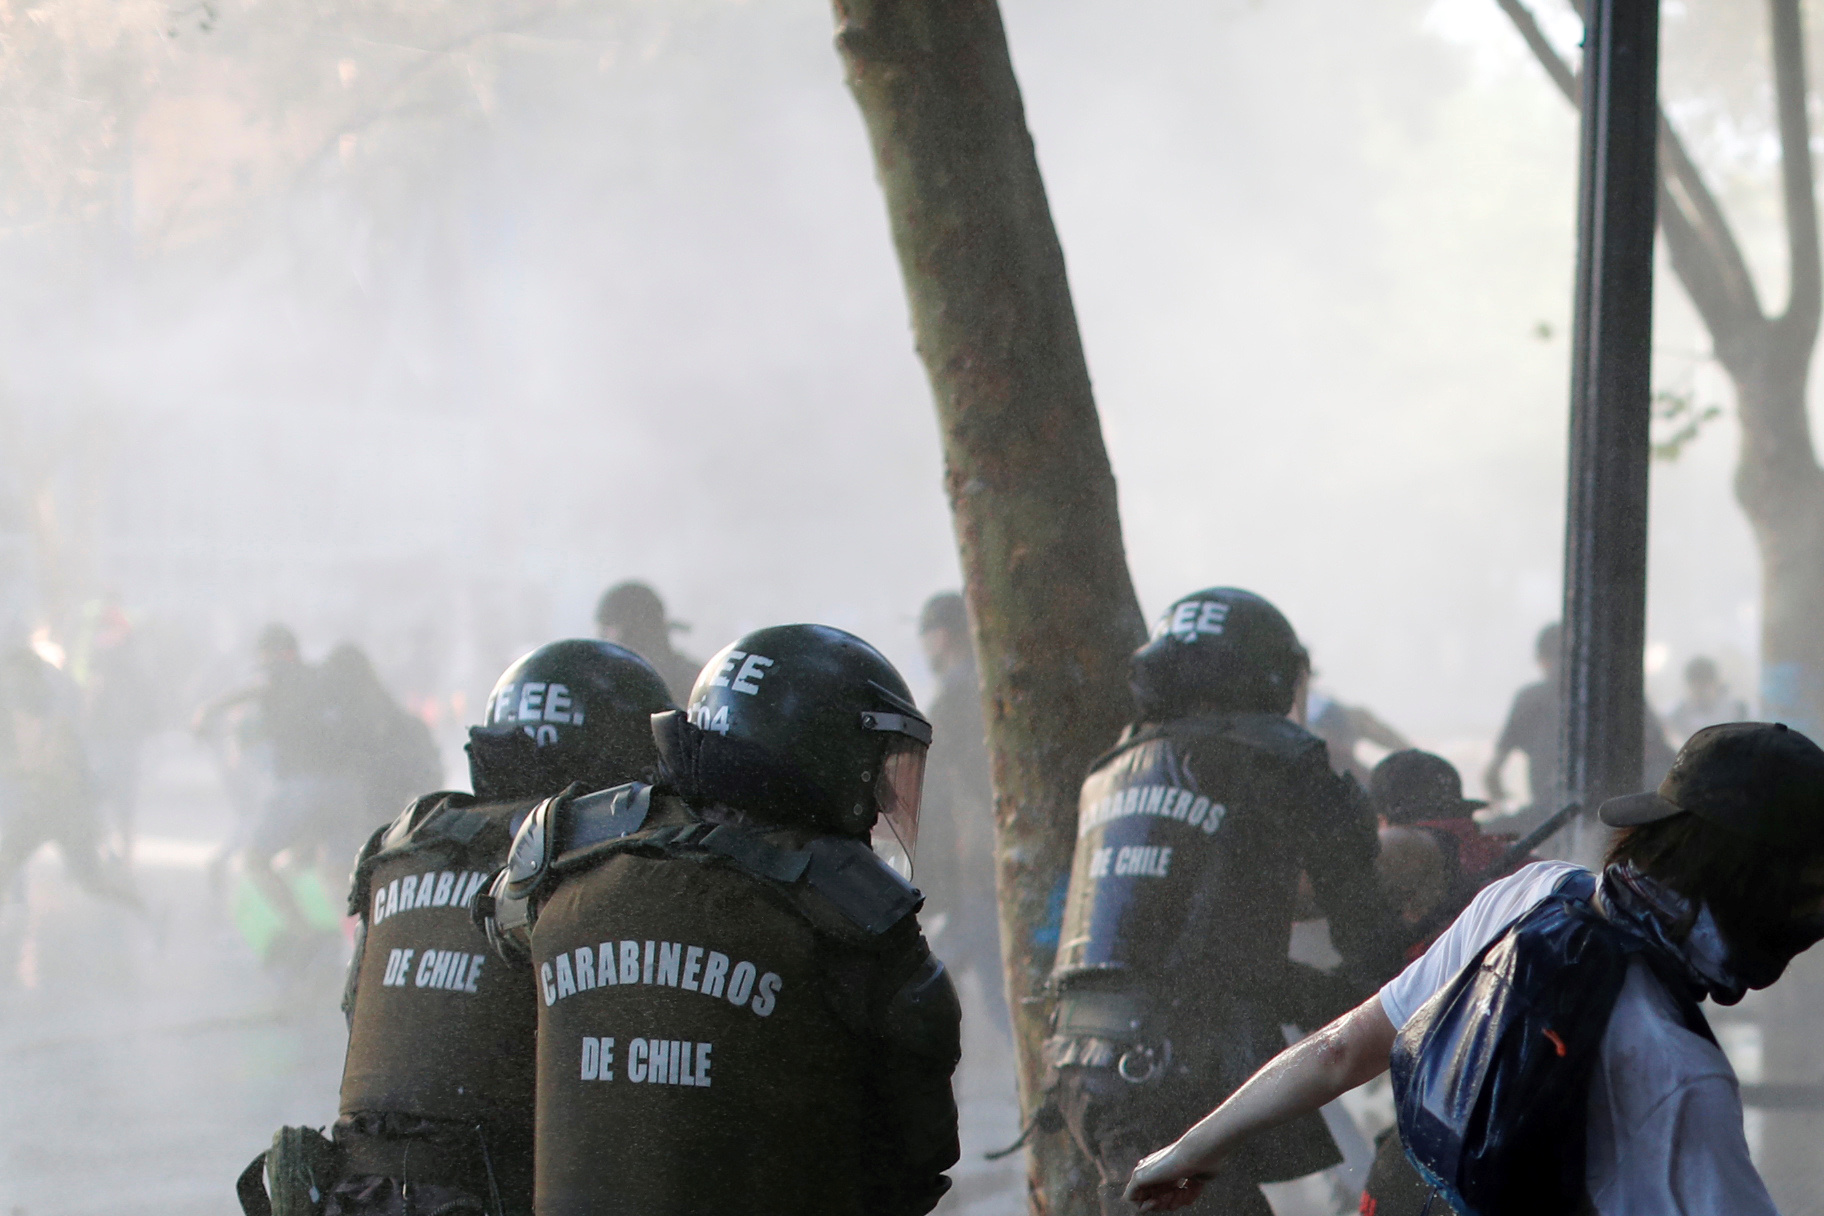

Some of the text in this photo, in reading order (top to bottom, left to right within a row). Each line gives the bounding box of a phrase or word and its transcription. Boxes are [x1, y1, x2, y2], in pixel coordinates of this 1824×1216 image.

[1114, 845, 1173, 878] CHILE
[373, 870, 488, 926] CARABIN
[382, 948, 486, 994] DE CHILE
[541, 940, 783, 1017] CARABINEROS
[580, 1036, 713, 1088] DE CHILE
